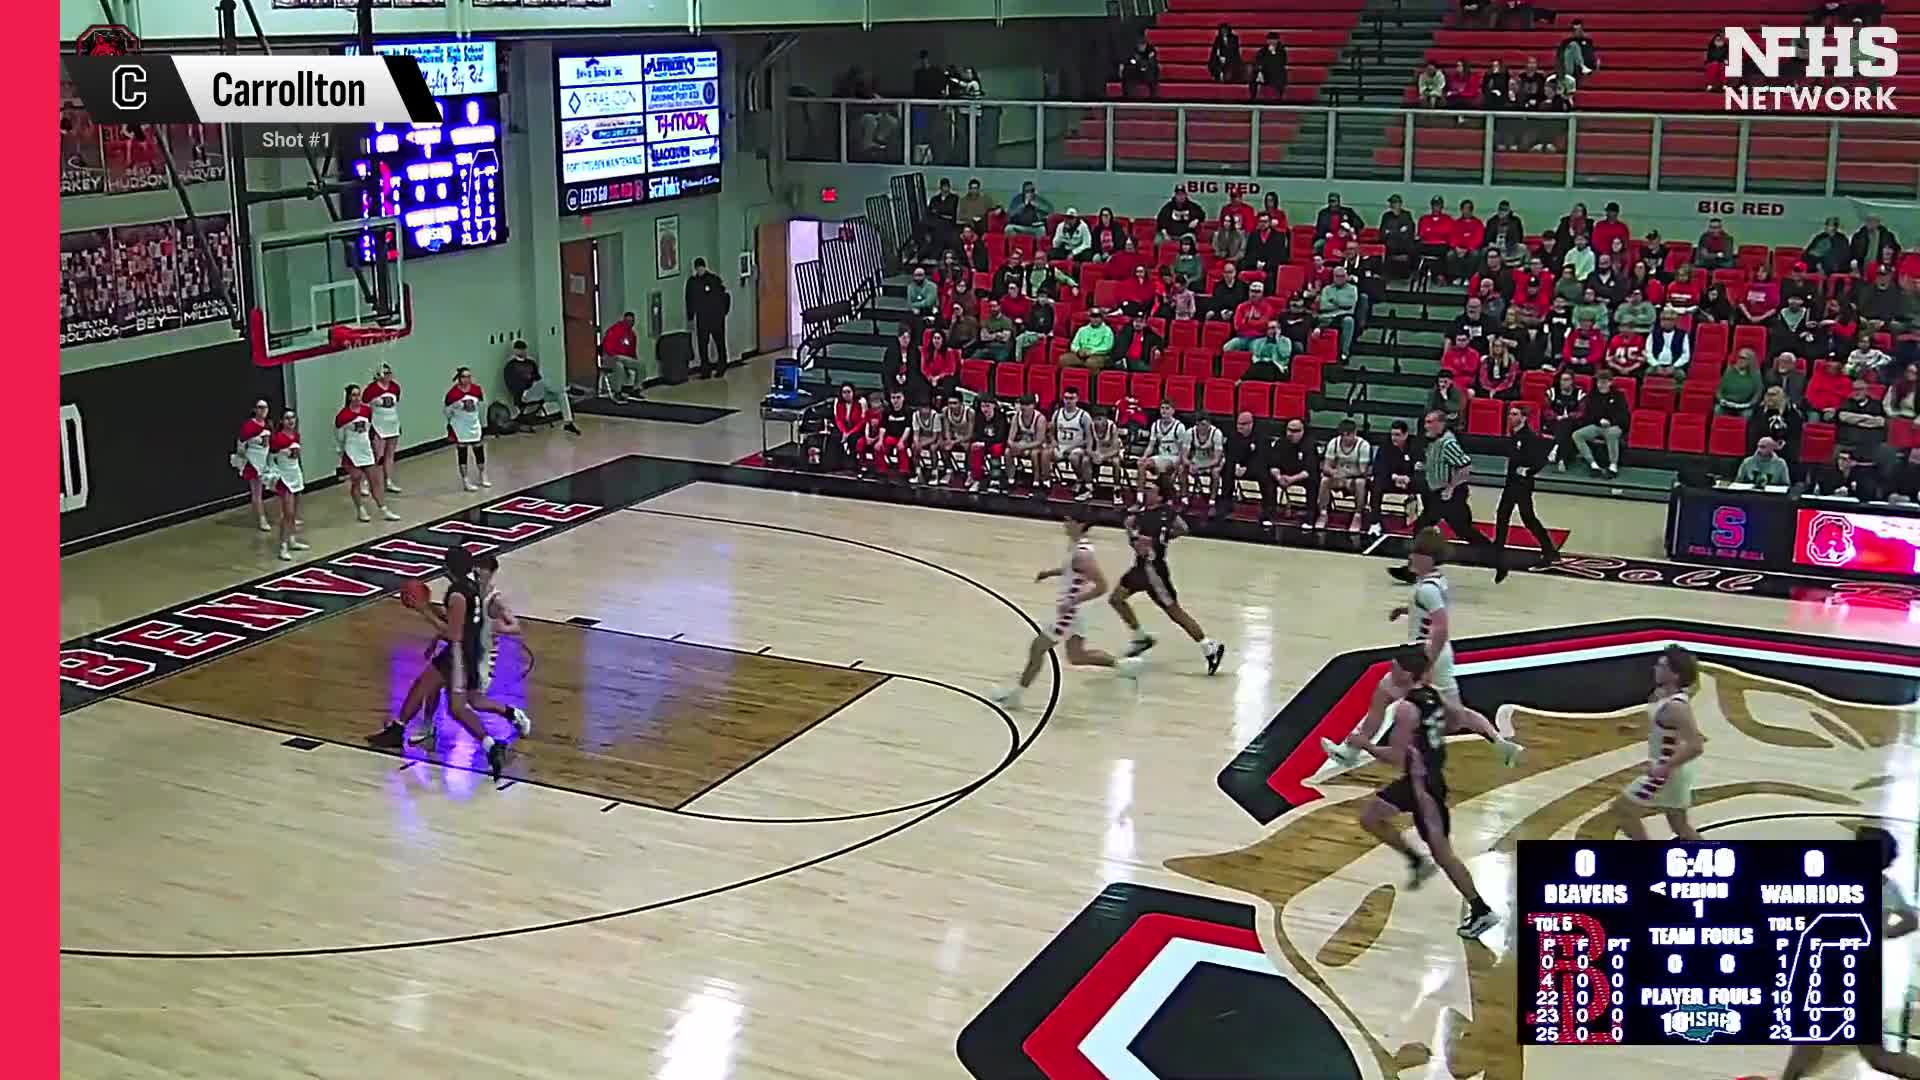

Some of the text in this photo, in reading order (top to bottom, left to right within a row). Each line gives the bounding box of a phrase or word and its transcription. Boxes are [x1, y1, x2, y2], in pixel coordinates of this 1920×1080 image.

[1187, 181, 1260, 194] BIG RED
[1698, 201, 1784, 216] BIG RED
